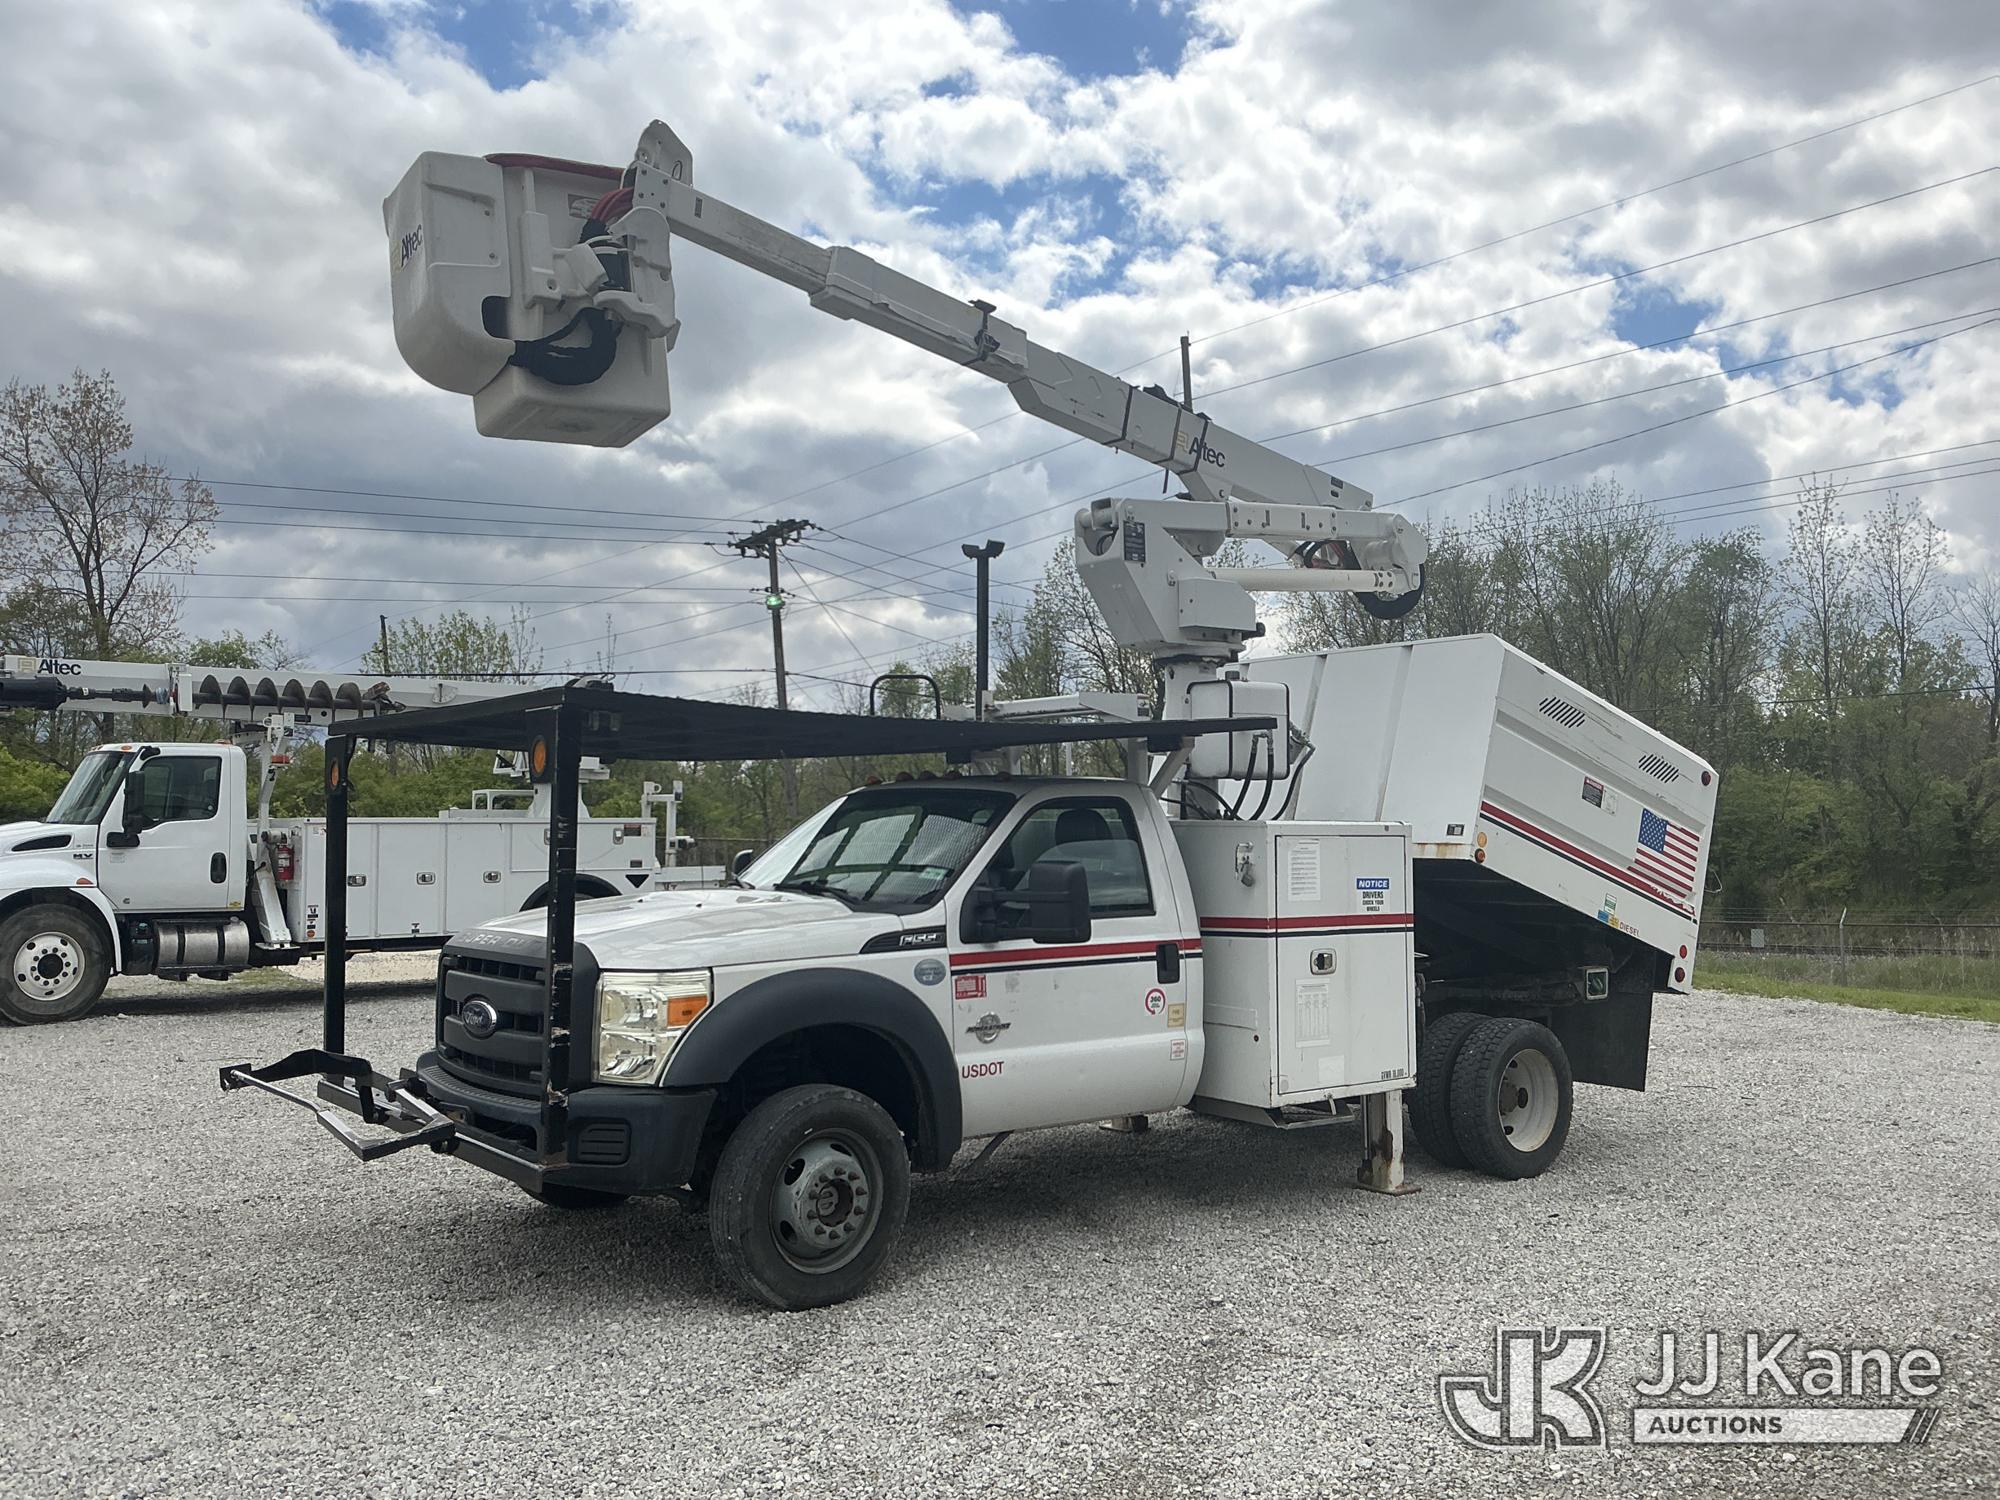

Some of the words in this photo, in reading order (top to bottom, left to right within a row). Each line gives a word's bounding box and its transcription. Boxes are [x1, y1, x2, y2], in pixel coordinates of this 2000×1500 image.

[401, 224, 422, 267] Altec
[38, 658, 81, 675] Altec
[1358, 880, 1388, 888] NOTICE
[1362, 891, 1384, 899] DRIVERS
[1619, 921, 1640, 938] DIESEL
[961, 1061, 1004, 1079] USDOT
